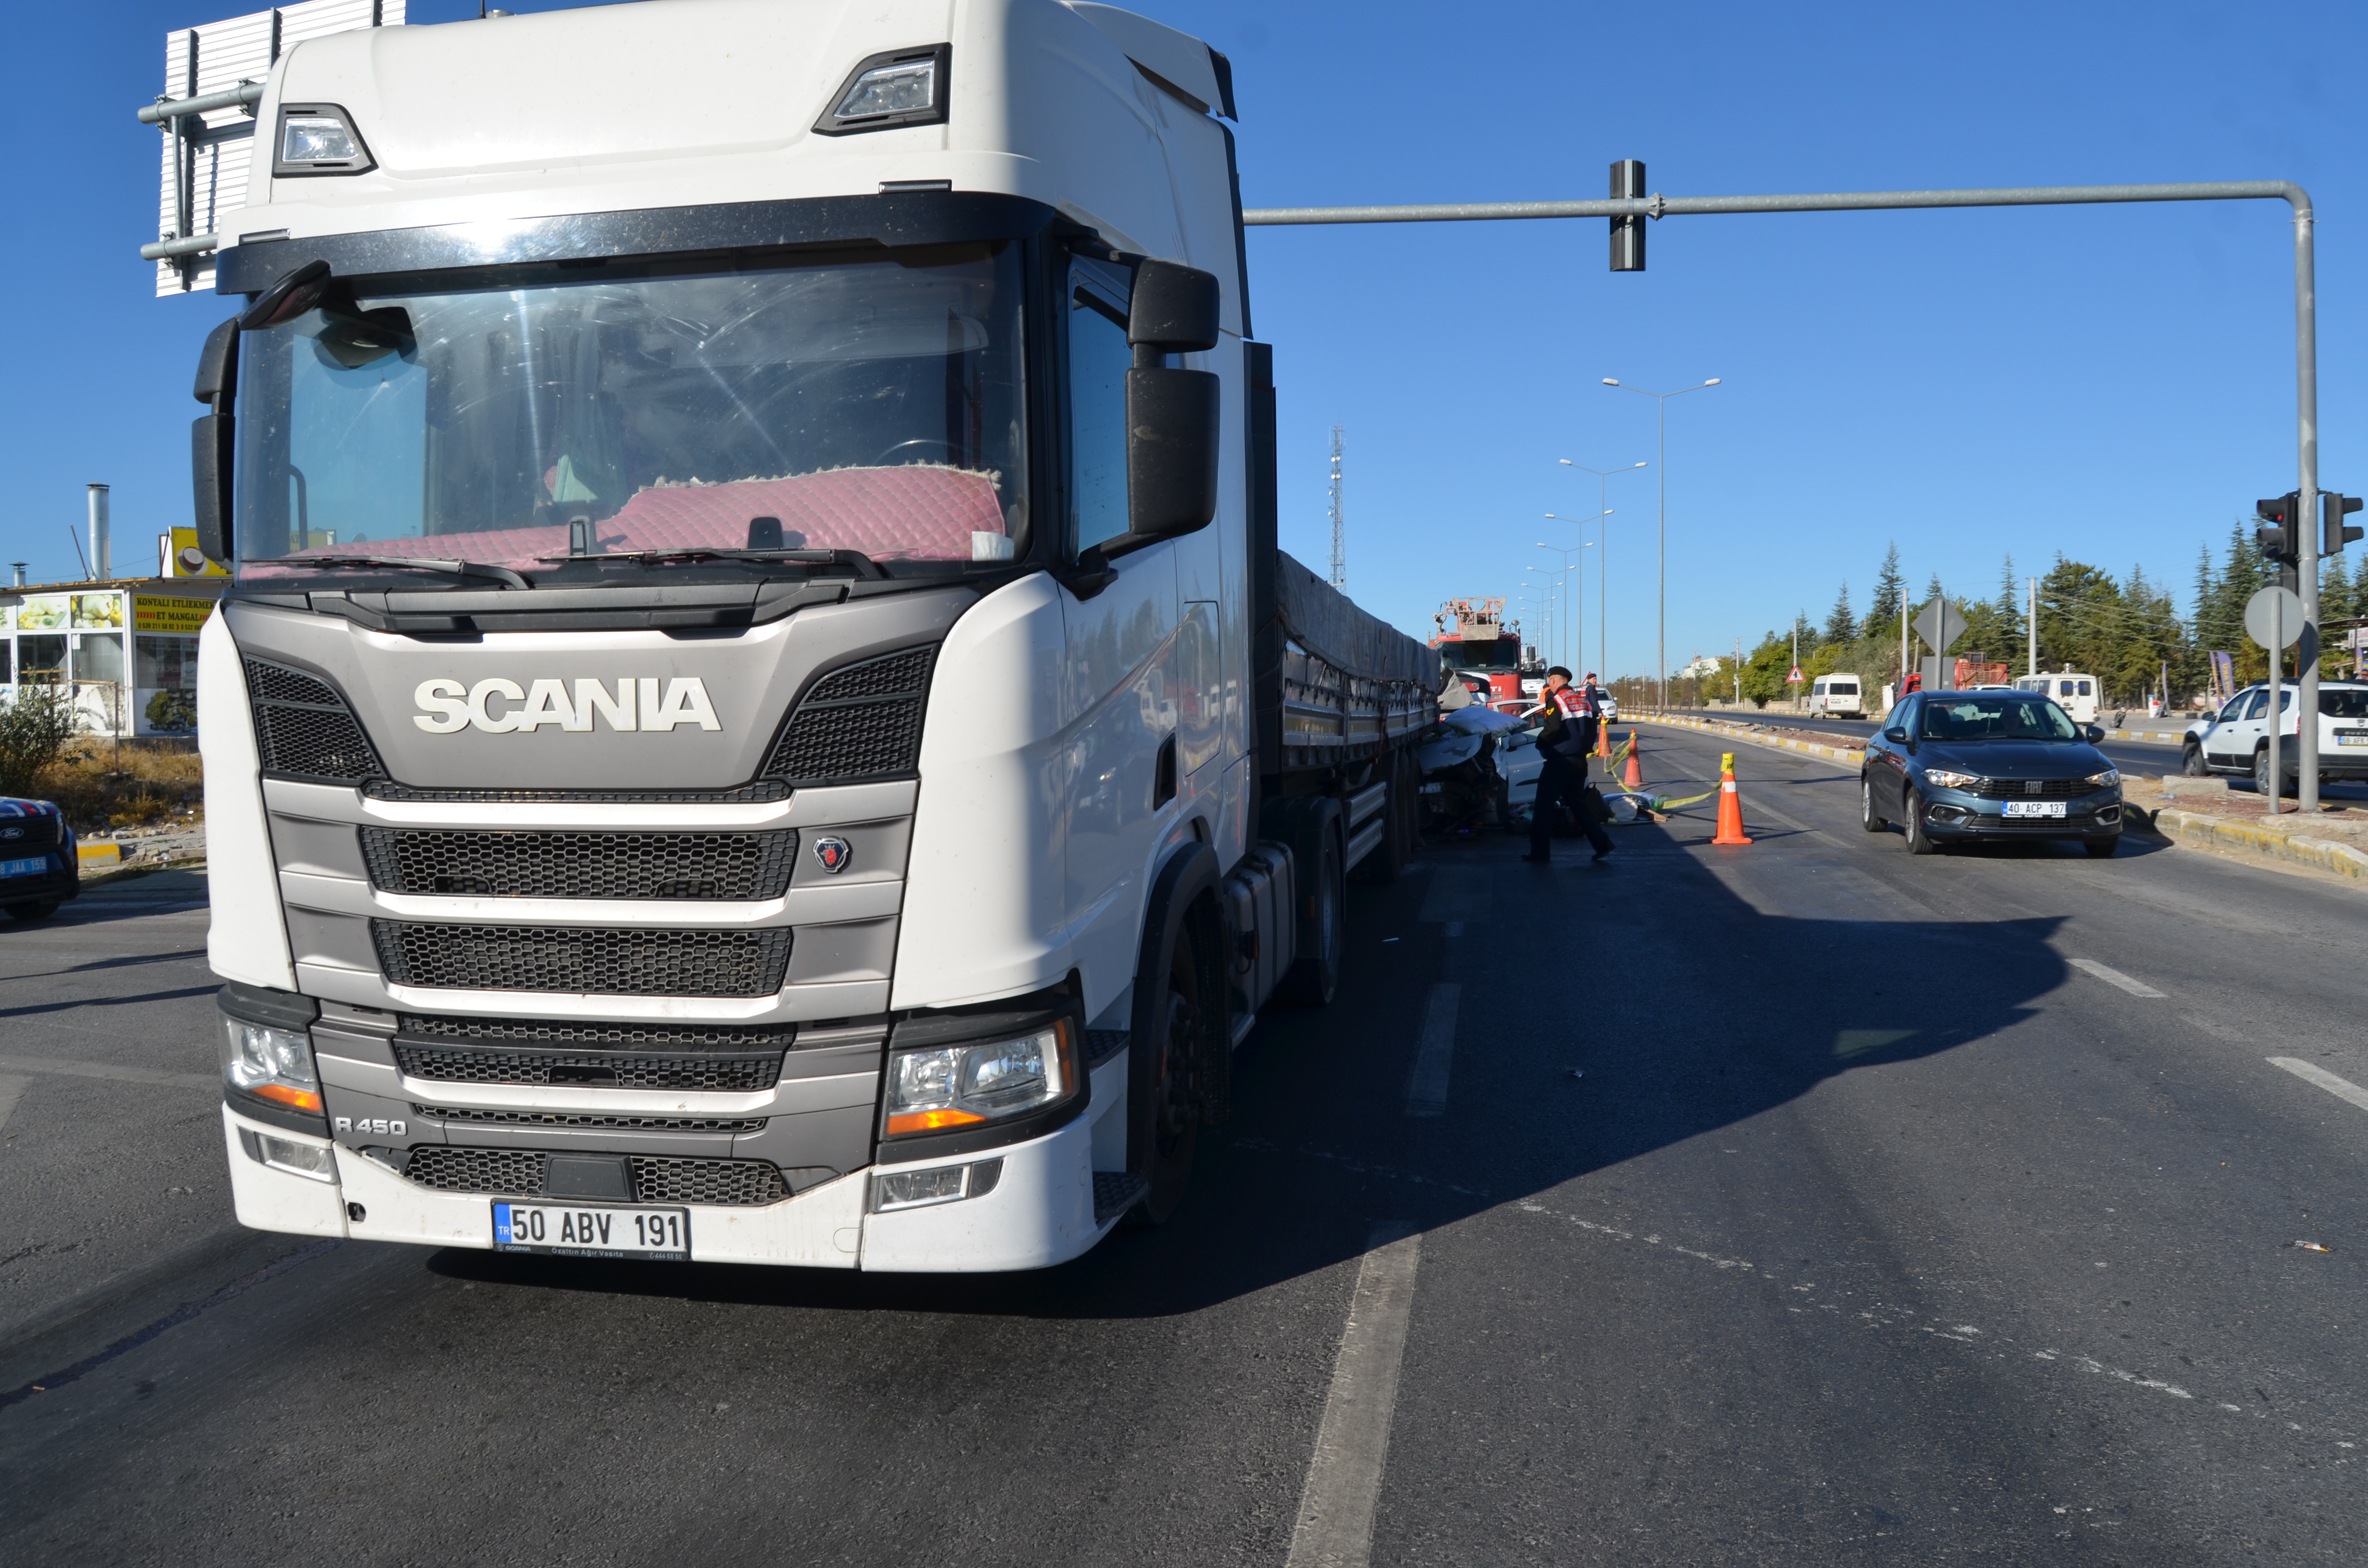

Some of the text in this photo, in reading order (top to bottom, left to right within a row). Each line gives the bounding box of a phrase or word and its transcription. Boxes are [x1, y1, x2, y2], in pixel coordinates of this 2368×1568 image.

[136, 598, 170, 607] KONYALI
[156, 612, 199, 621] ET MANGAL
[413, 677, 723, 734] SCANIA
[2025, 781, 2043, 794] FIAT
[2008, 803, 2020, 813] 40
[2025, 803, 2042, 813] ACP
[2049, 803, 2065, 813] 137
[11, 861, 25, 872] JAA
[31, 859, 45, 870] 159
[335, 1117, 407, 1136] R 450
[497, 1209, 679, 1247] TR 50 ABV 191
